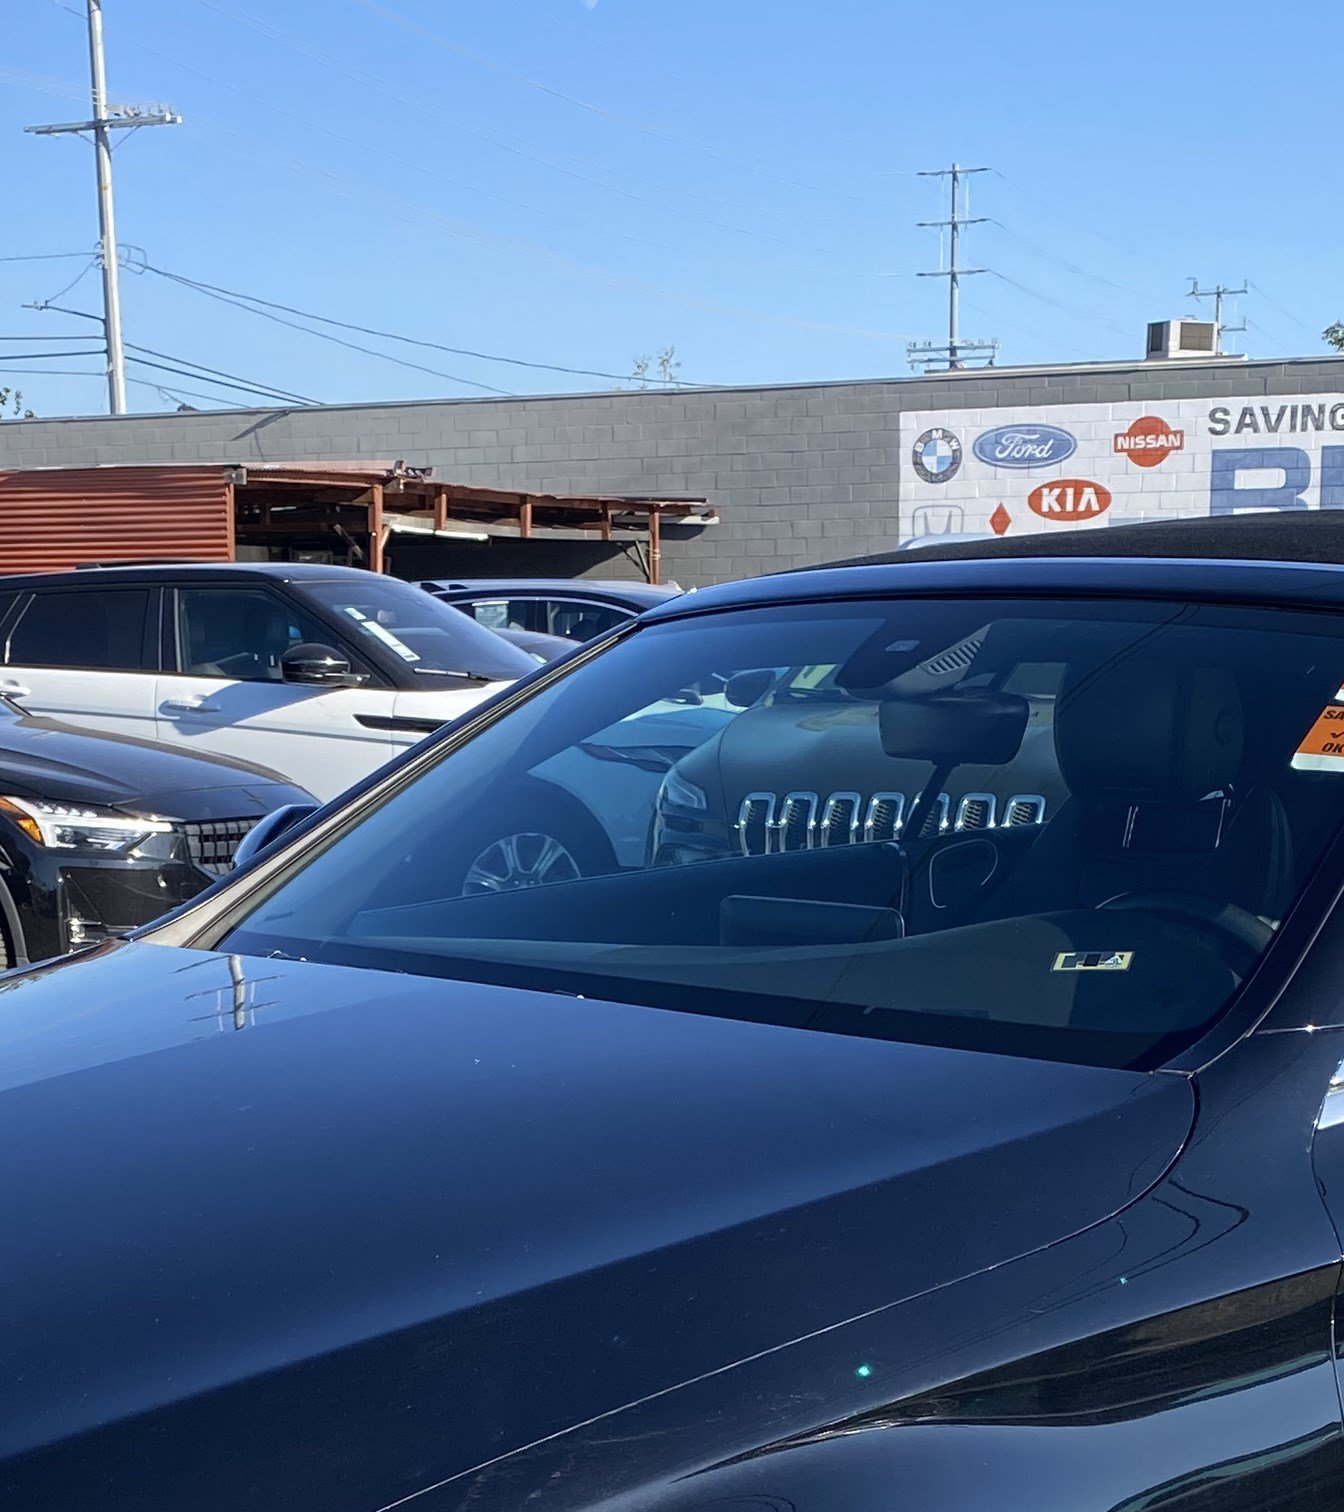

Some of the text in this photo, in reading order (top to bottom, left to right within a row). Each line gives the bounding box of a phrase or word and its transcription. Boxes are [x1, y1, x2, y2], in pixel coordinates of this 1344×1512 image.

[995, 432, 1054, 458] Ford
[1116, 433, 1181, 450] NISSAN
[1040, 486, 1102, 512] KIA
